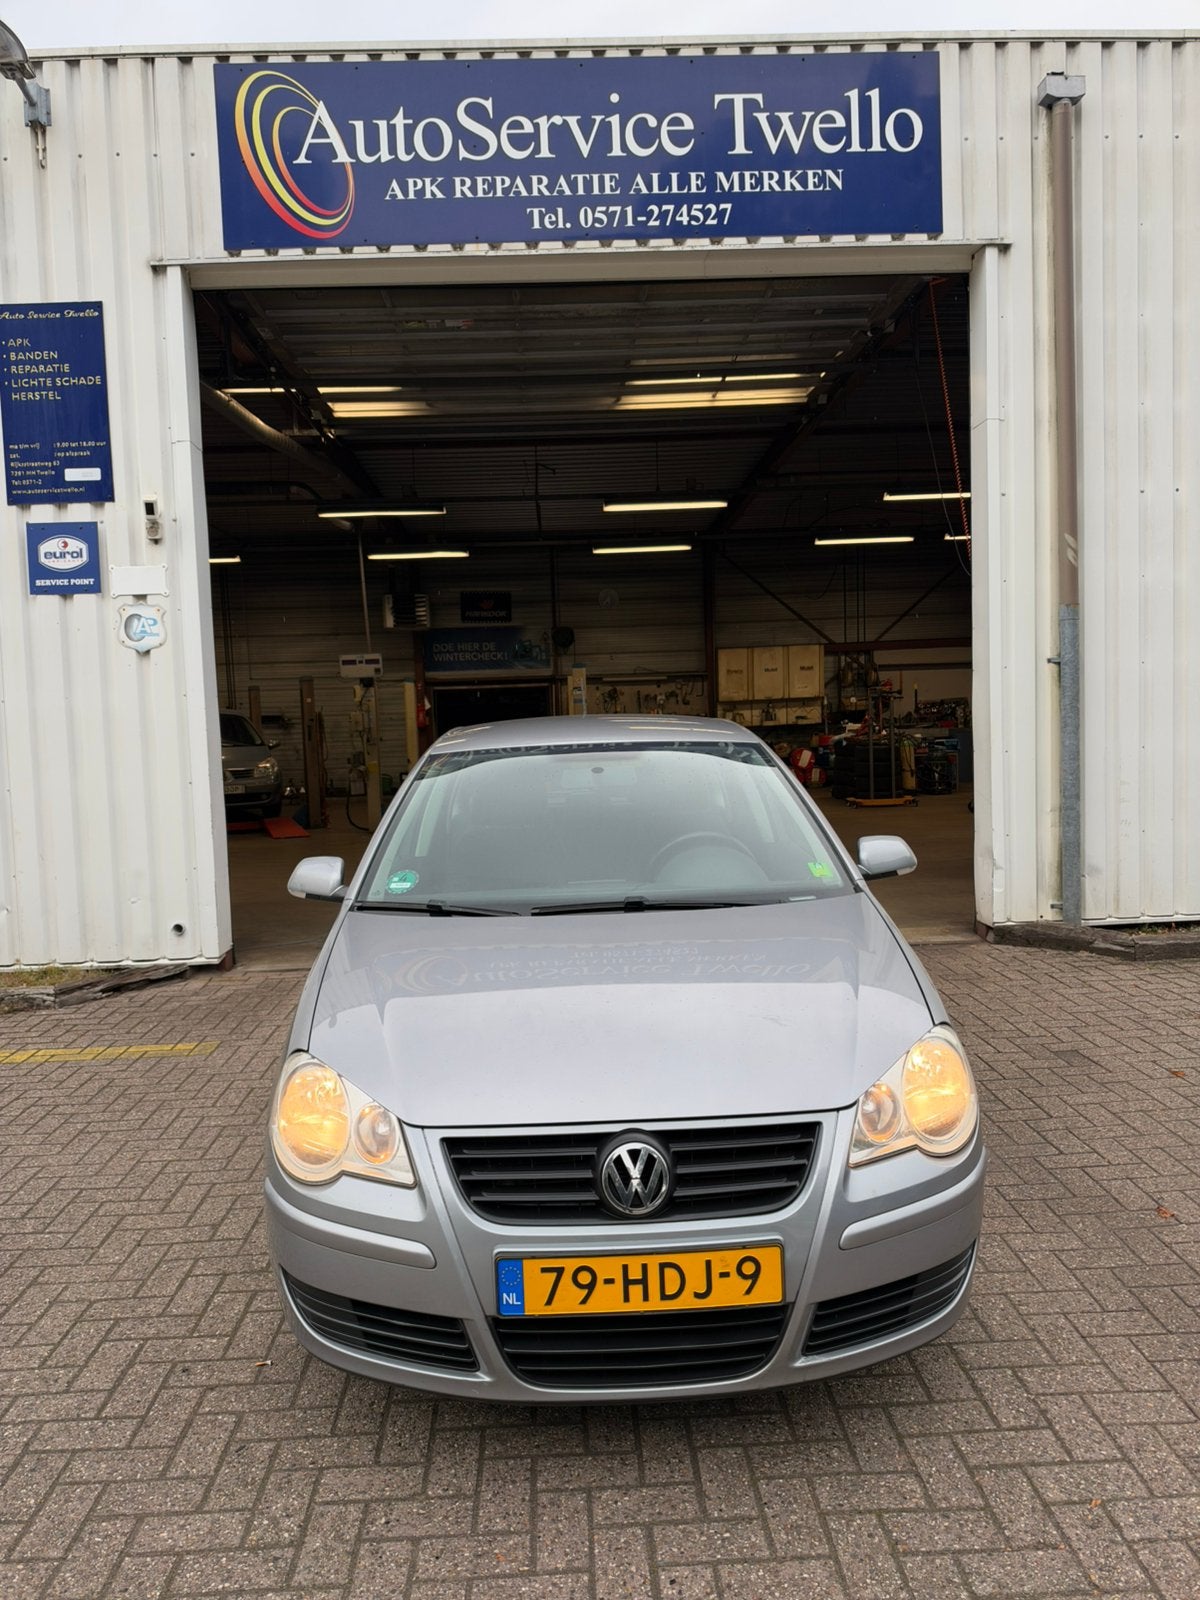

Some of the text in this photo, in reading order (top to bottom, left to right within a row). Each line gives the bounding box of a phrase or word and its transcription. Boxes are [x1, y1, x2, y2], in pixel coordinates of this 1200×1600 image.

[293, 87, 924, 165] AutoService Twello
[384, 168, 844, 201] APK REPARATIE ALLE MERKEN
[527, 202, 733, 230] Tel. 0571-274527
[7, 338, 31, 347] APK
[9, 351, 58, 361] BANDEN
[11, 364, 70, 374] REPARATIE
[11, 375, 102, 388] LICHTE SCHADE
[11, 391, 62, 401] HERSTEL
[44, 547, 83, 560] eurol
[35, 578, 95, 587] SERVICE POINT
[433, 642, 496, 651] DOE HIER DE
[433, 652, 508, 662] WINTERCHECK!
[540, 1255, 762, 1307] 79-HDJ-9
[503, 1292, 521, 1305] NL
